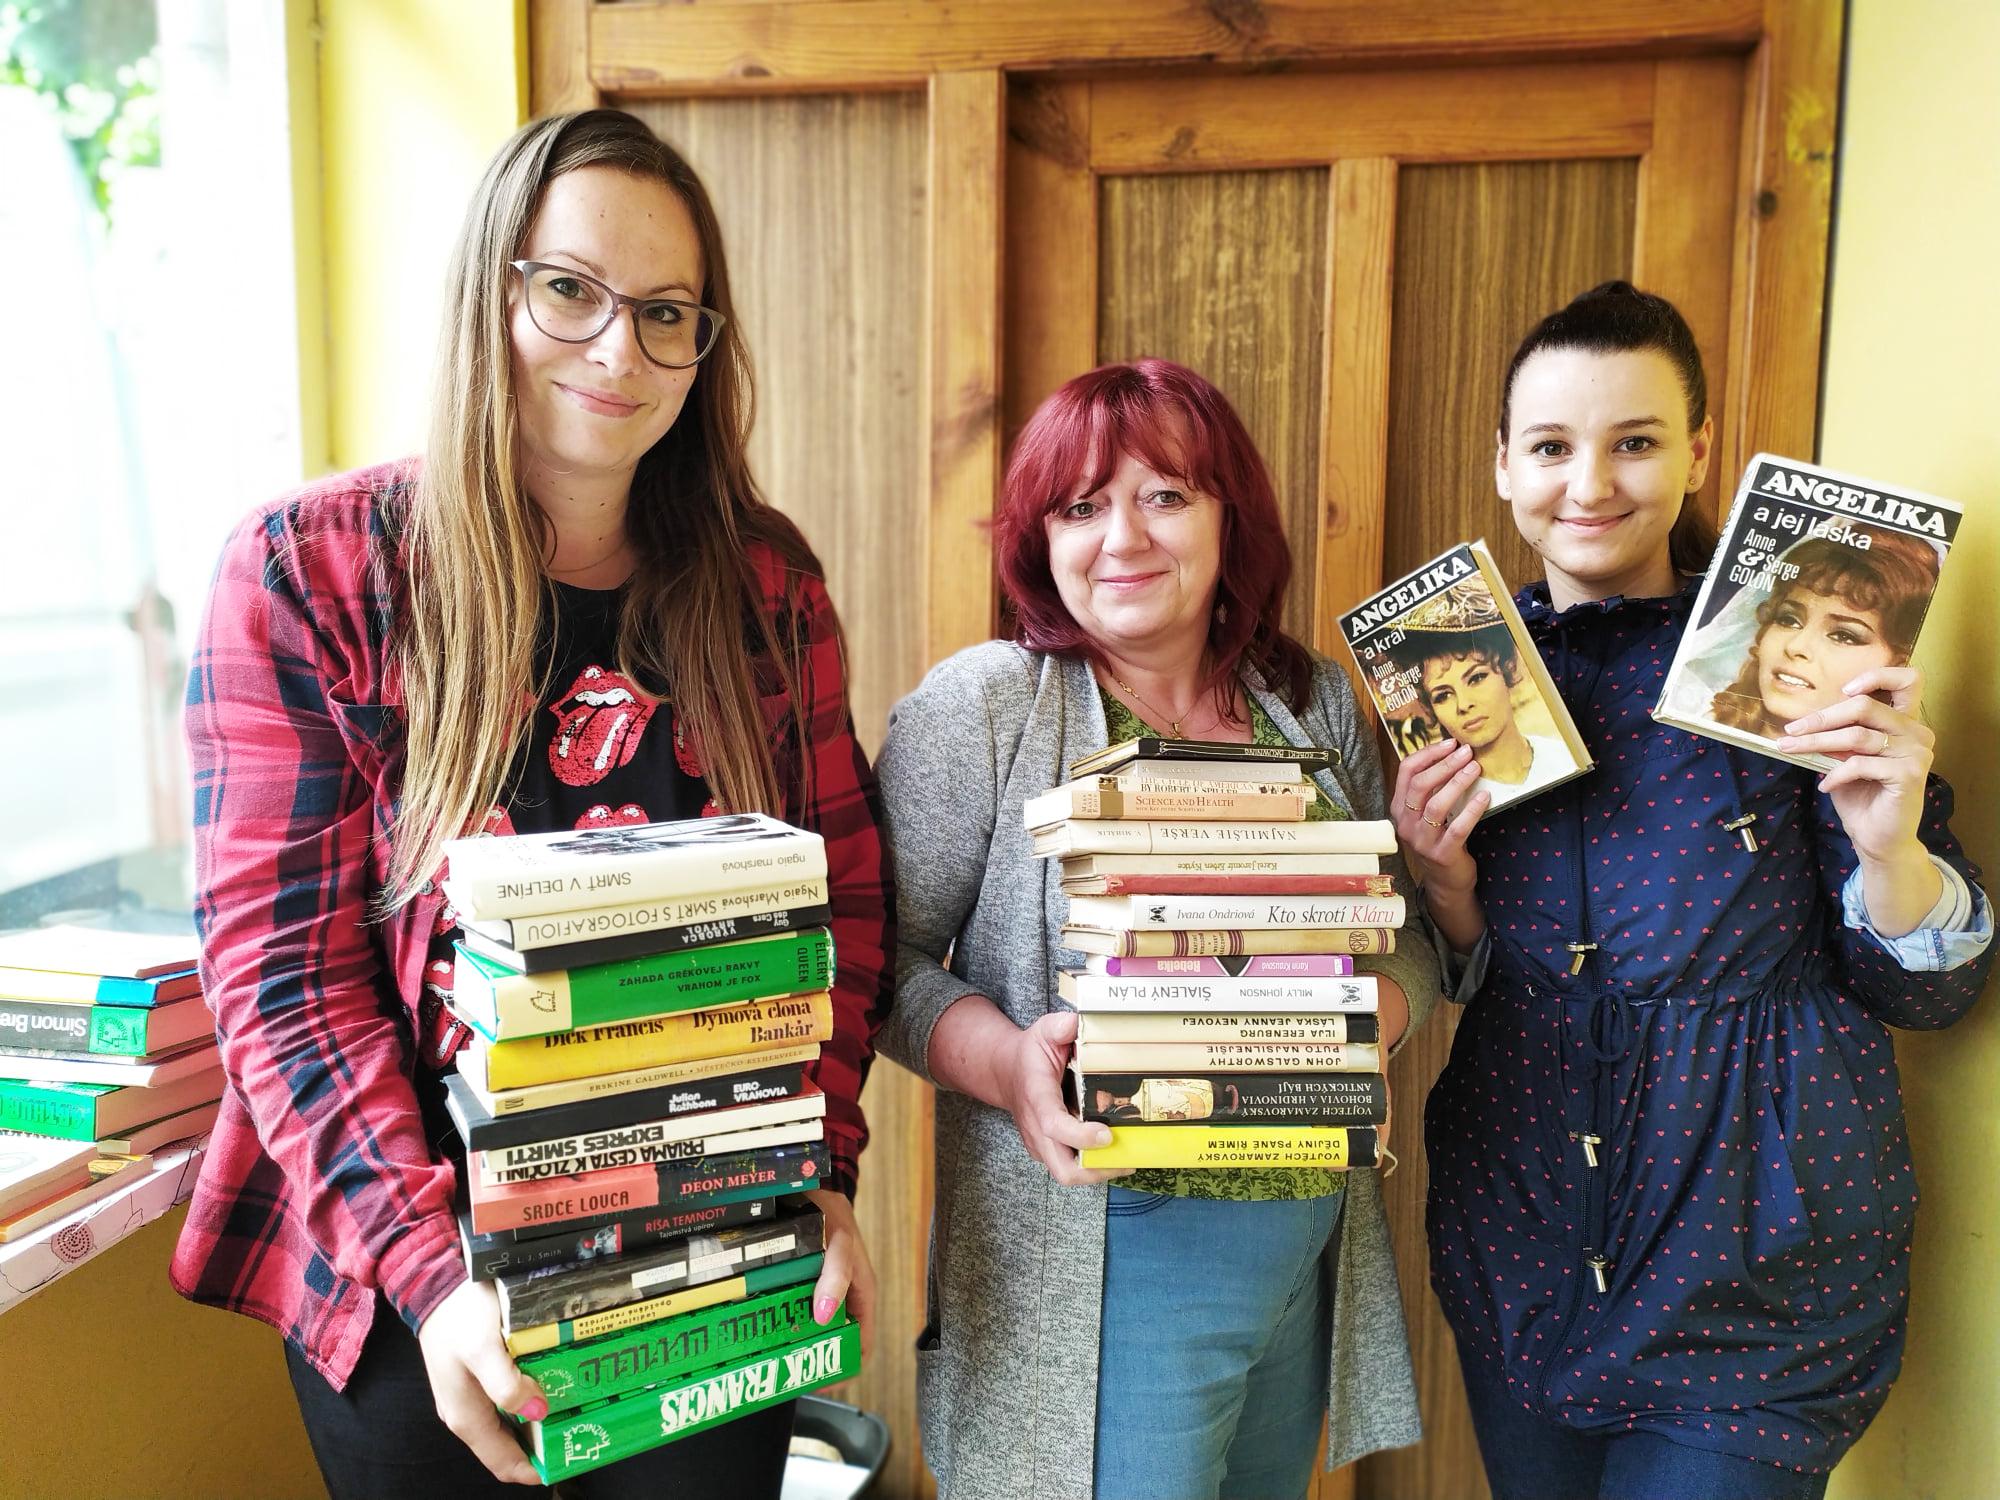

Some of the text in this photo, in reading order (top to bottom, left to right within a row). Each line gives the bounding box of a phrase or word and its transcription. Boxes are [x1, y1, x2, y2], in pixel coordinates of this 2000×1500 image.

[1761, 469, 1948, 537] ANGELIKA
[1753, 505, 1768, 523] a
[1771, 508, 1805, 535] jej
[1743, 528, 1777, 552] Anne
[1737, 548, 1800, 580] & Serge
[1729, 564, 1776, 593] GOLON
[1352, 556, 1472, 638] ANGELIKA
[1364, 646, 1375, 660] a
[1372, 661, 1396, 681] Anne
[1380, 665, 1422, 695] & Serge
[1385, 684, 1418, 712] GOLON
[1141, 784, 1151, 792] BY
[1160, 828, 1296, 841] NAJMILŠIE VERŠE
[722, 853, 806, 872] ngaio marshová
[498, 872, 631, 899] SMRŤ V DELFÍNE
[529, 885, 819, 941] Ngaio Marshová SMRŤ S FOTOGRAFIOU
[774, 918, 789, 927] Guy
[1178, 905, 1394, 923] Ivana Ondriová Kto skrotí Kláru
[725, 960, 760, 972] RAKVY
[797, 947, 809, 983] QUEEN
[815, 942, 828, 983] ELLERY
[1158, 959, 1200, 972] Rebelka
[1292, 962, 1309, 972] Karin
[677, 974, 761, 993] VRAHOM JE FOX
[1240, 988, 1312, 997] MILLY JOHNSON
[1108, 986, 1212, 1001] ŠIALENÝ PLÁN
[31, 1013, 87, 1036] Simon
[544, 1000, 811, 1048] Dick Francis Dymová clona
[1183, 1018, 1335, 1026] LÁSKA JEANNY NEYOVEJ
[750, 1022, 813, 1043] Bankár
[1206, 1045, 1340, 1055] PUTO NAJSILNEJŠIE
[1209, 1057, 1341, 1066] JOHN GALSWORTHY
[589, 1080, 631, 1092] ERSKINE
[635, 1070, 684, 1084] CALDWELL
[1278, 1082, 1372, 1093] ANTICKÝCH BÁJÍ
[669, 1092, 701, 1104] Julian
[733, 1086, 789, 1102] VRAHOVIA
[1241, 1095, 1372, 1104] BOHOVIA A HRDINOVIA
[8, 1097, 85, 1129] ARTHUR
[669, 1098, 717, 1113] Rathbone
[1241, 1107, 1372, 1117] VOJTECH ZAMAROVSKÝ
[507, 1125, 664, 1166] EXPRES SMRTI
[641, 1139, 704, 1162] PRIAMA
[1208, 1140, 1340, 1150] DĚJINY PSANÉ ŘÍMEM
[575, 1157, 587, 1172] K
[591, 1151, 637, 1169] CESTA
[1285, 1153, 1340, 1161] VOJTĚCH
[681, 1170, 776, 1194] DEON MEYER
[523, 1200, 573, 1221] SRDCE
[645, 1207, 727, 1233] RÍŠA TEMNOTY
[659, 1227, 692, 1239] Tajomstvá
[538, 1249, 562, 1259] Smith
[578, 1326, 708, 1389] UPFIELD
[660, 1336, 842, 1436] DICK FRANCIS
